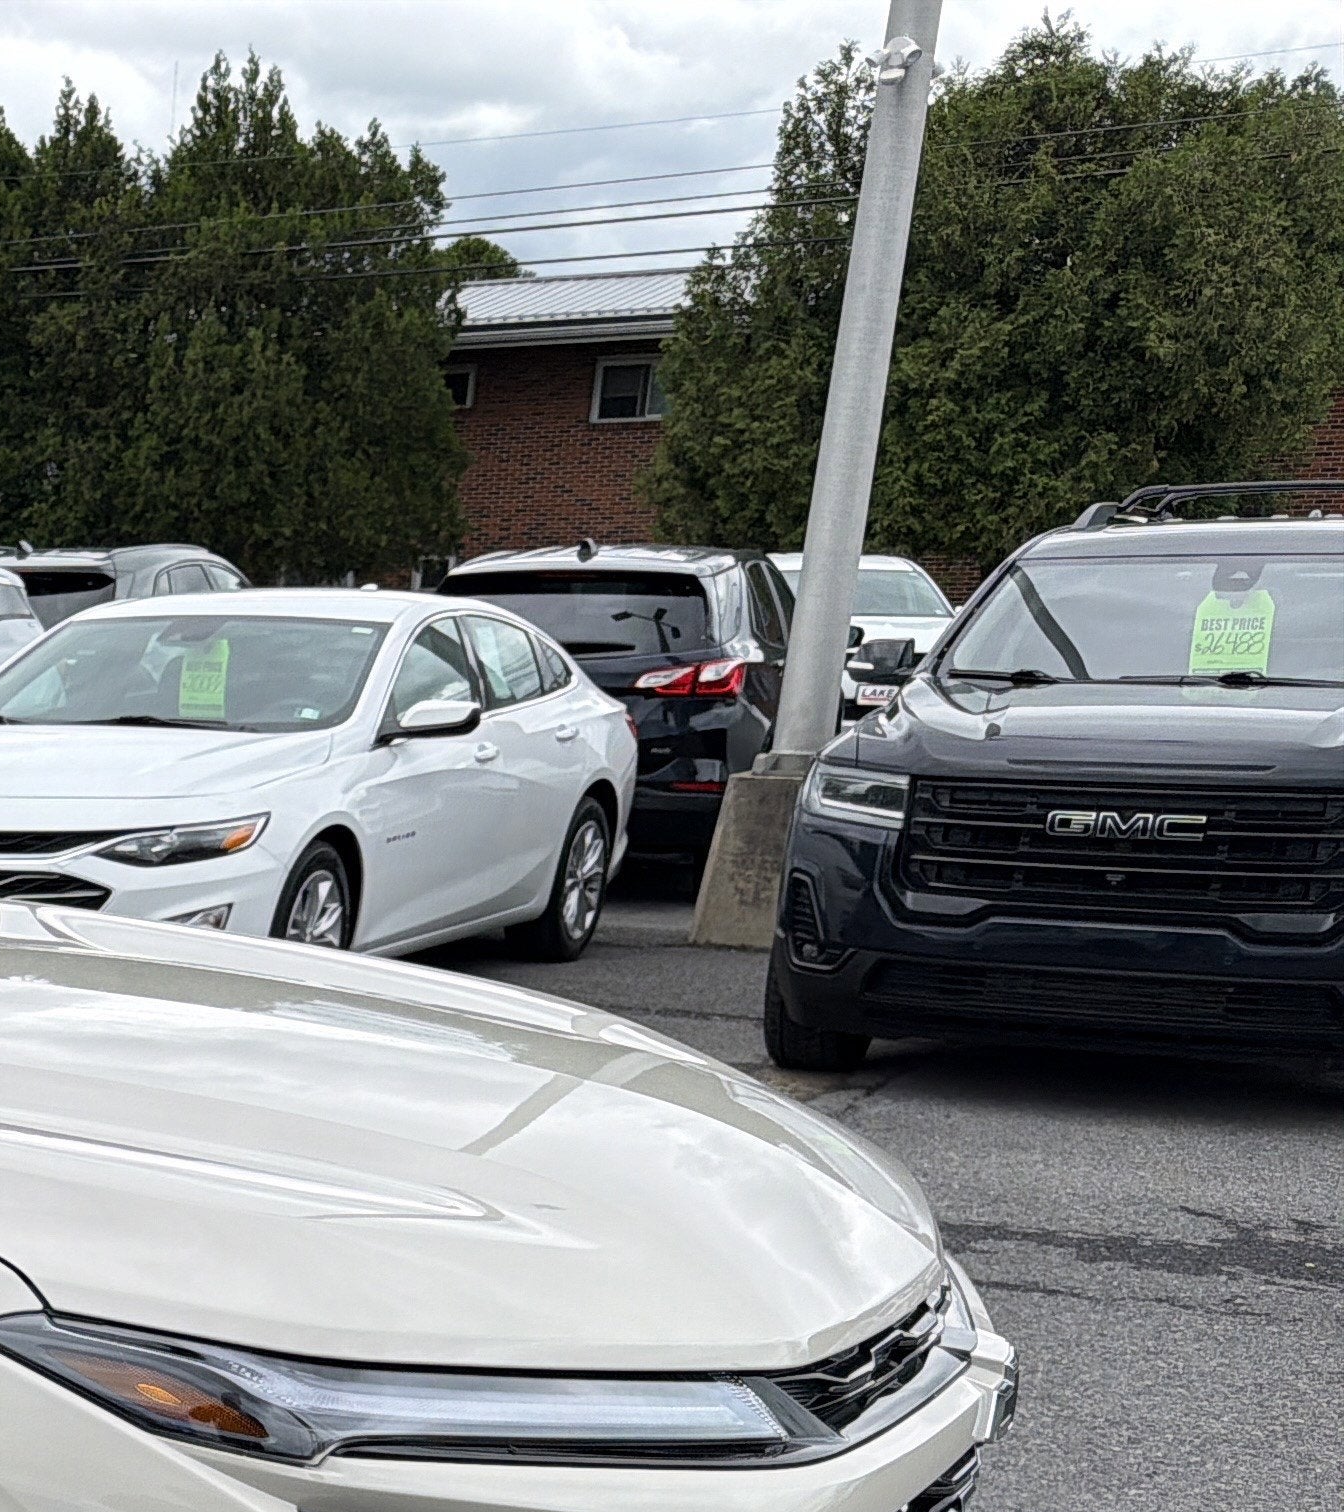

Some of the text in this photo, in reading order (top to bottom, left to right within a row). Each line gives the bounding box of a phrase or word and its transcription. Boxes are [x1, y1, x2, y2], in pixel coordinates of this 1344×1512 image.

[1200, 616, 1266, 632] BEST PRICE
[861, 688, 896, 698] LAKE
[1045, 810, 1207, 842] GMC
